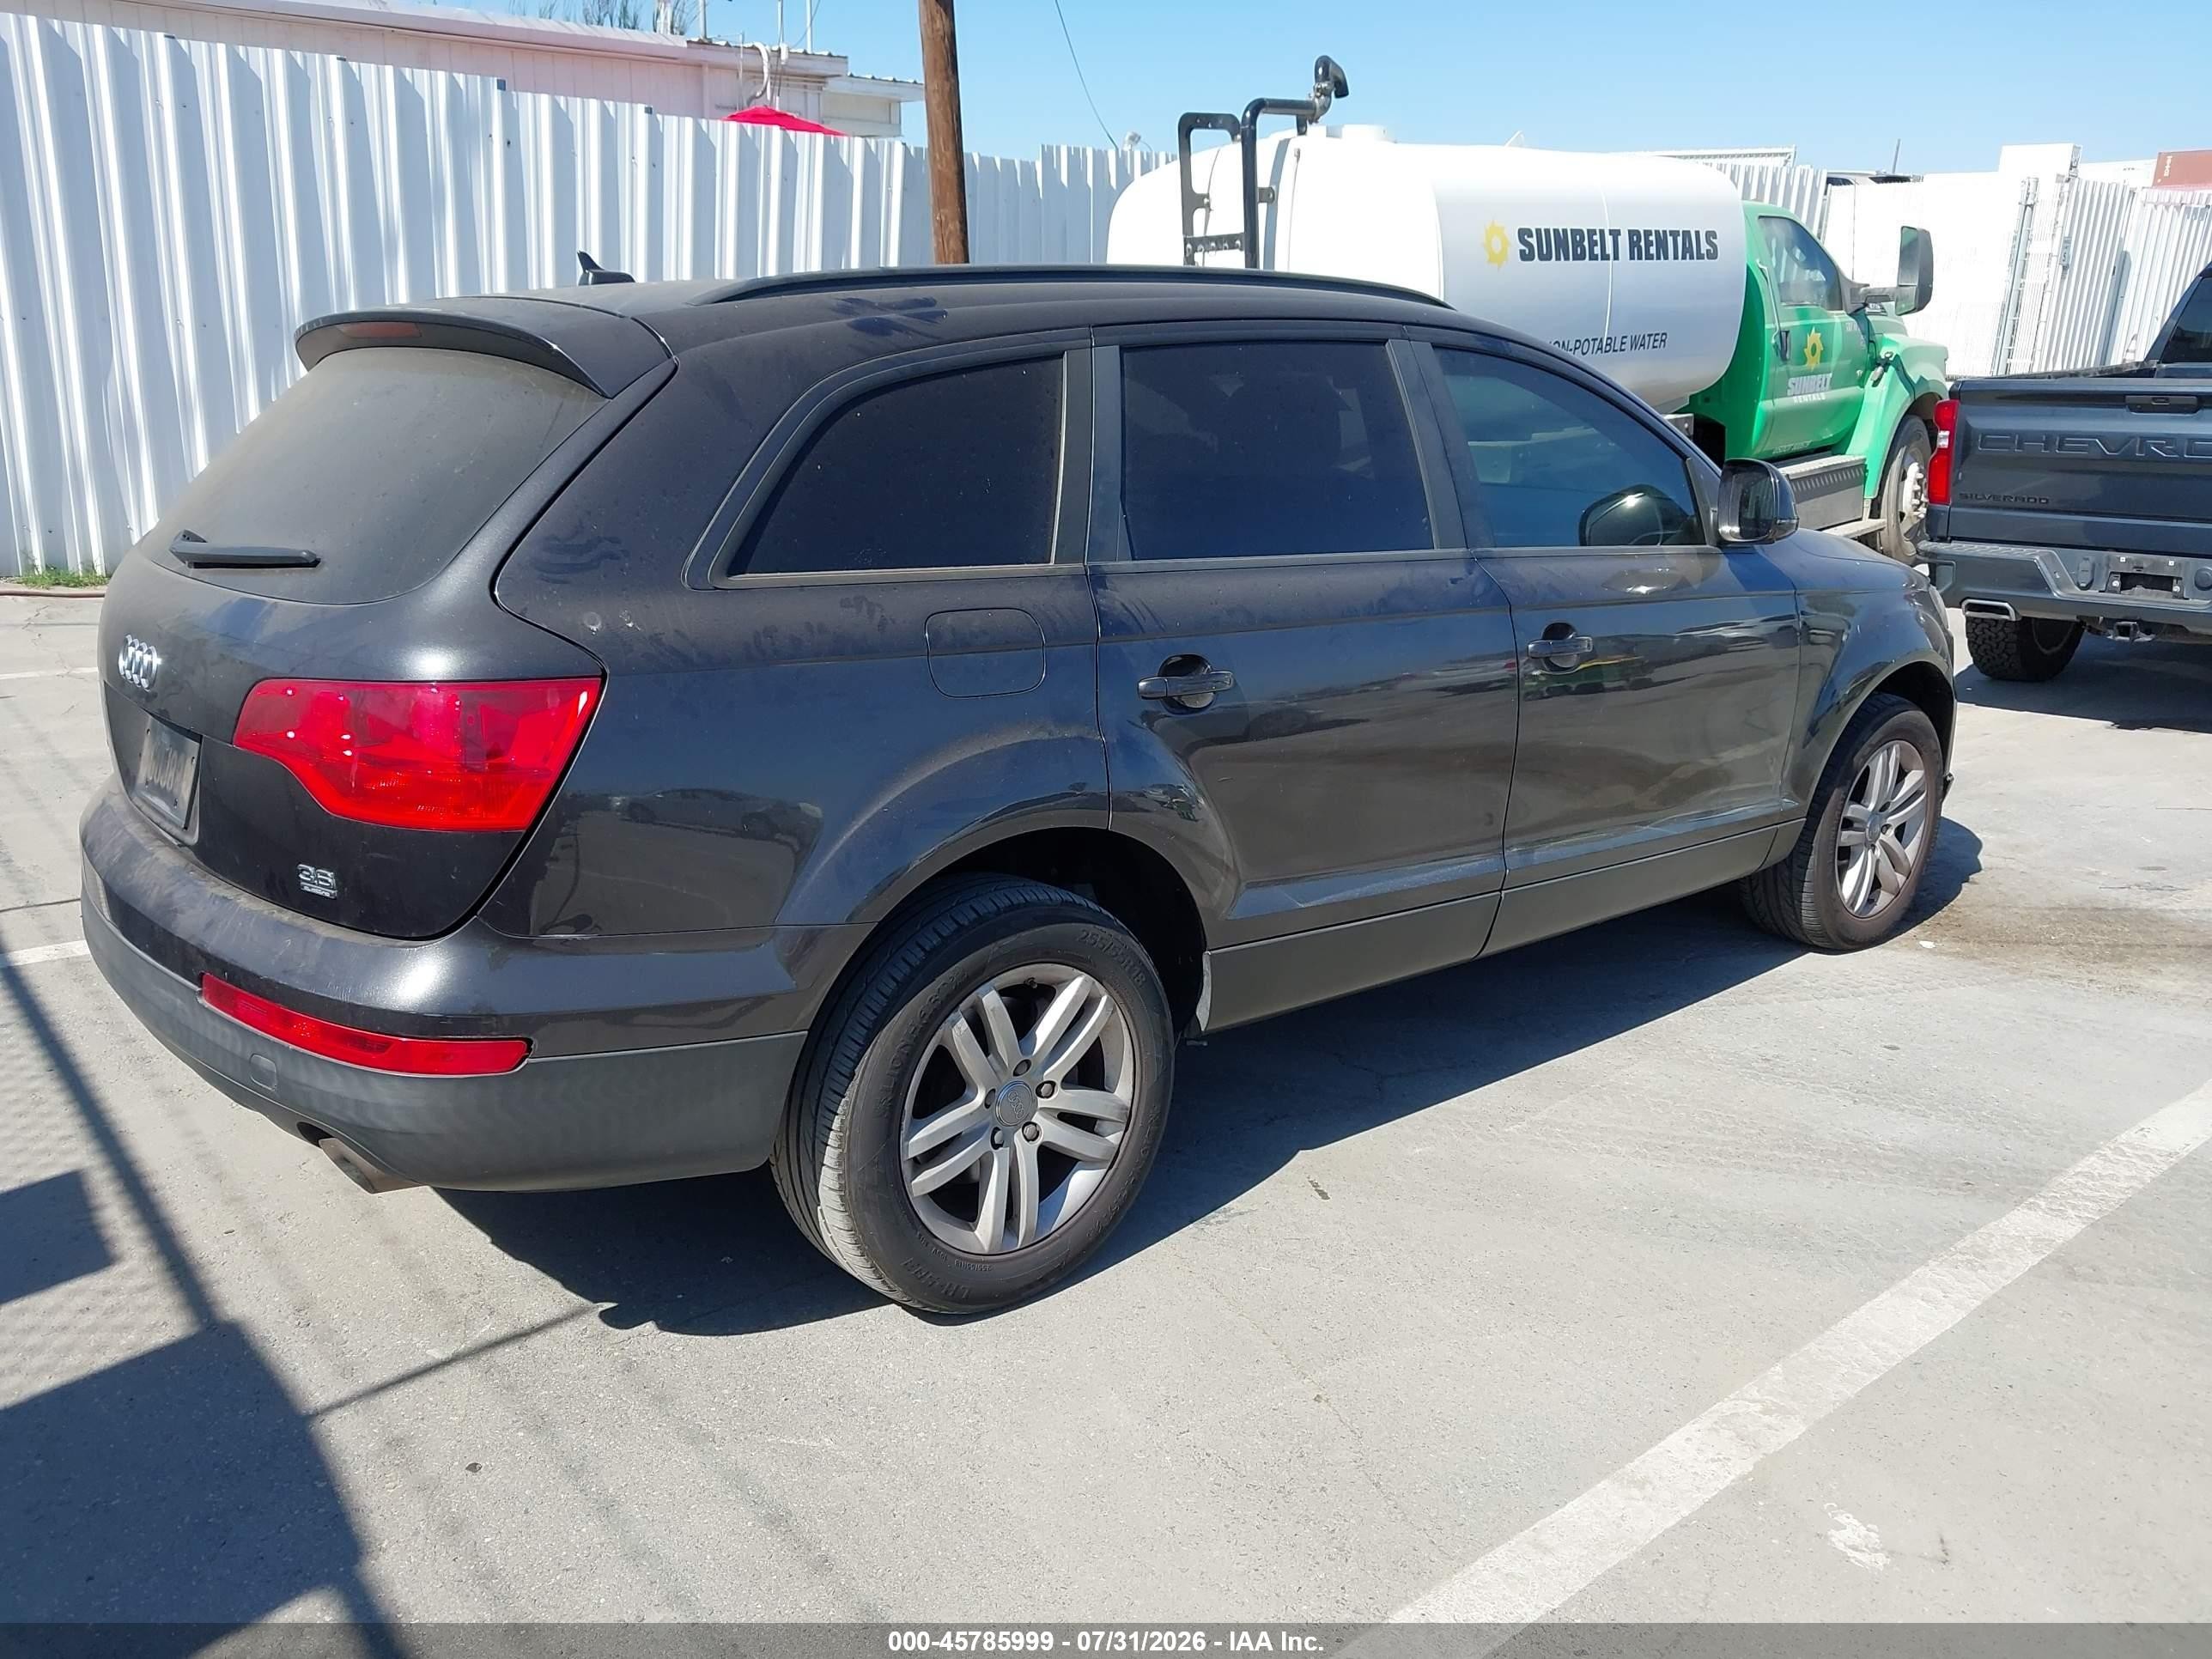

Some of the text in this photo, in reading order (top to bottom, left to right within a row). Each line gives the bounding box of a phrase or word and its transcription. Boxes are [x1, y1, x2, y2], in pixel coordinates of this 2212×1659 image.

[1517, 228, 1718, 261] SUNBELT RENTALS
[1630, 332, 1668, 350] WATER
[1787, 373, 1832, 396] SUNBELT
[1960, 494, 2049, 505] SILVERADO
